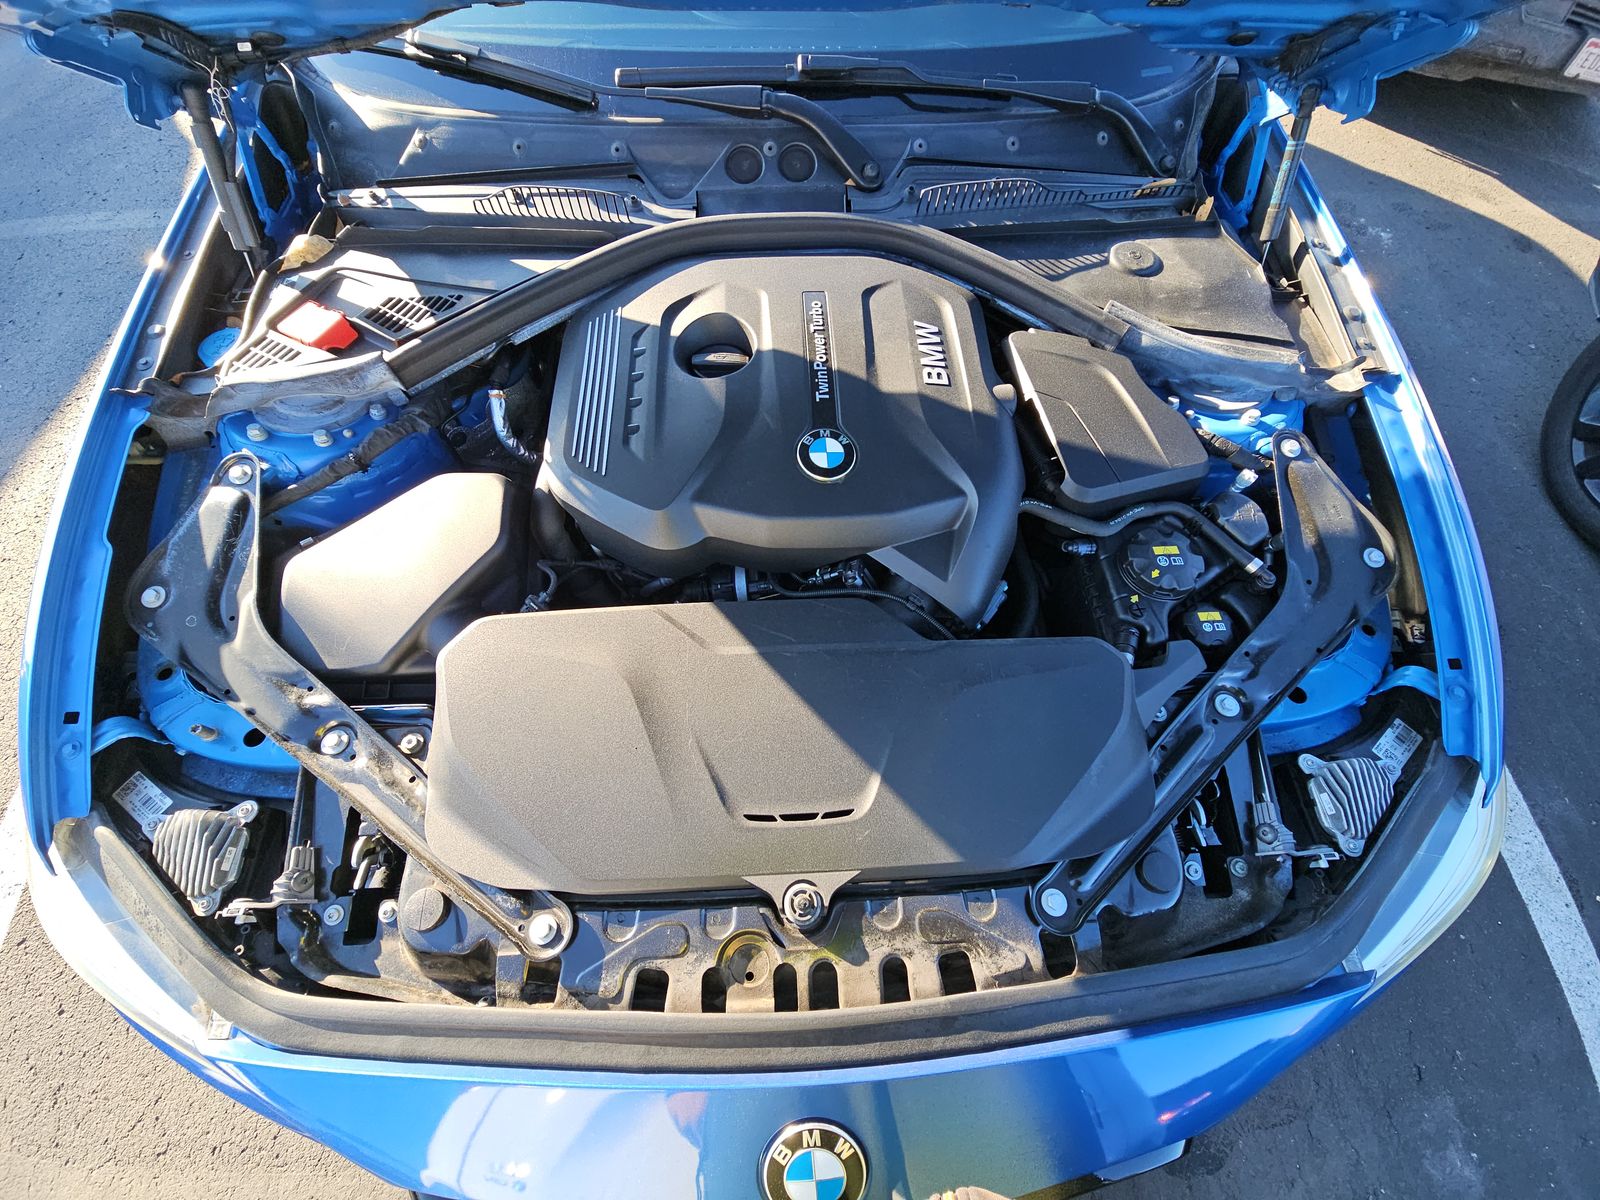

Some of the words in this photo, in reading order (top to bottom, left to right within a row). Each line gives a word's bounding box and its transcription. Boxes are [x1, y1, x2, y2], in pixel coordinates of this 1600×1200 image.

[914, 320, 950, 387] BMW
[802, 429, 851, 446] BMW
[773, 1130, 856, 1167] BMW
